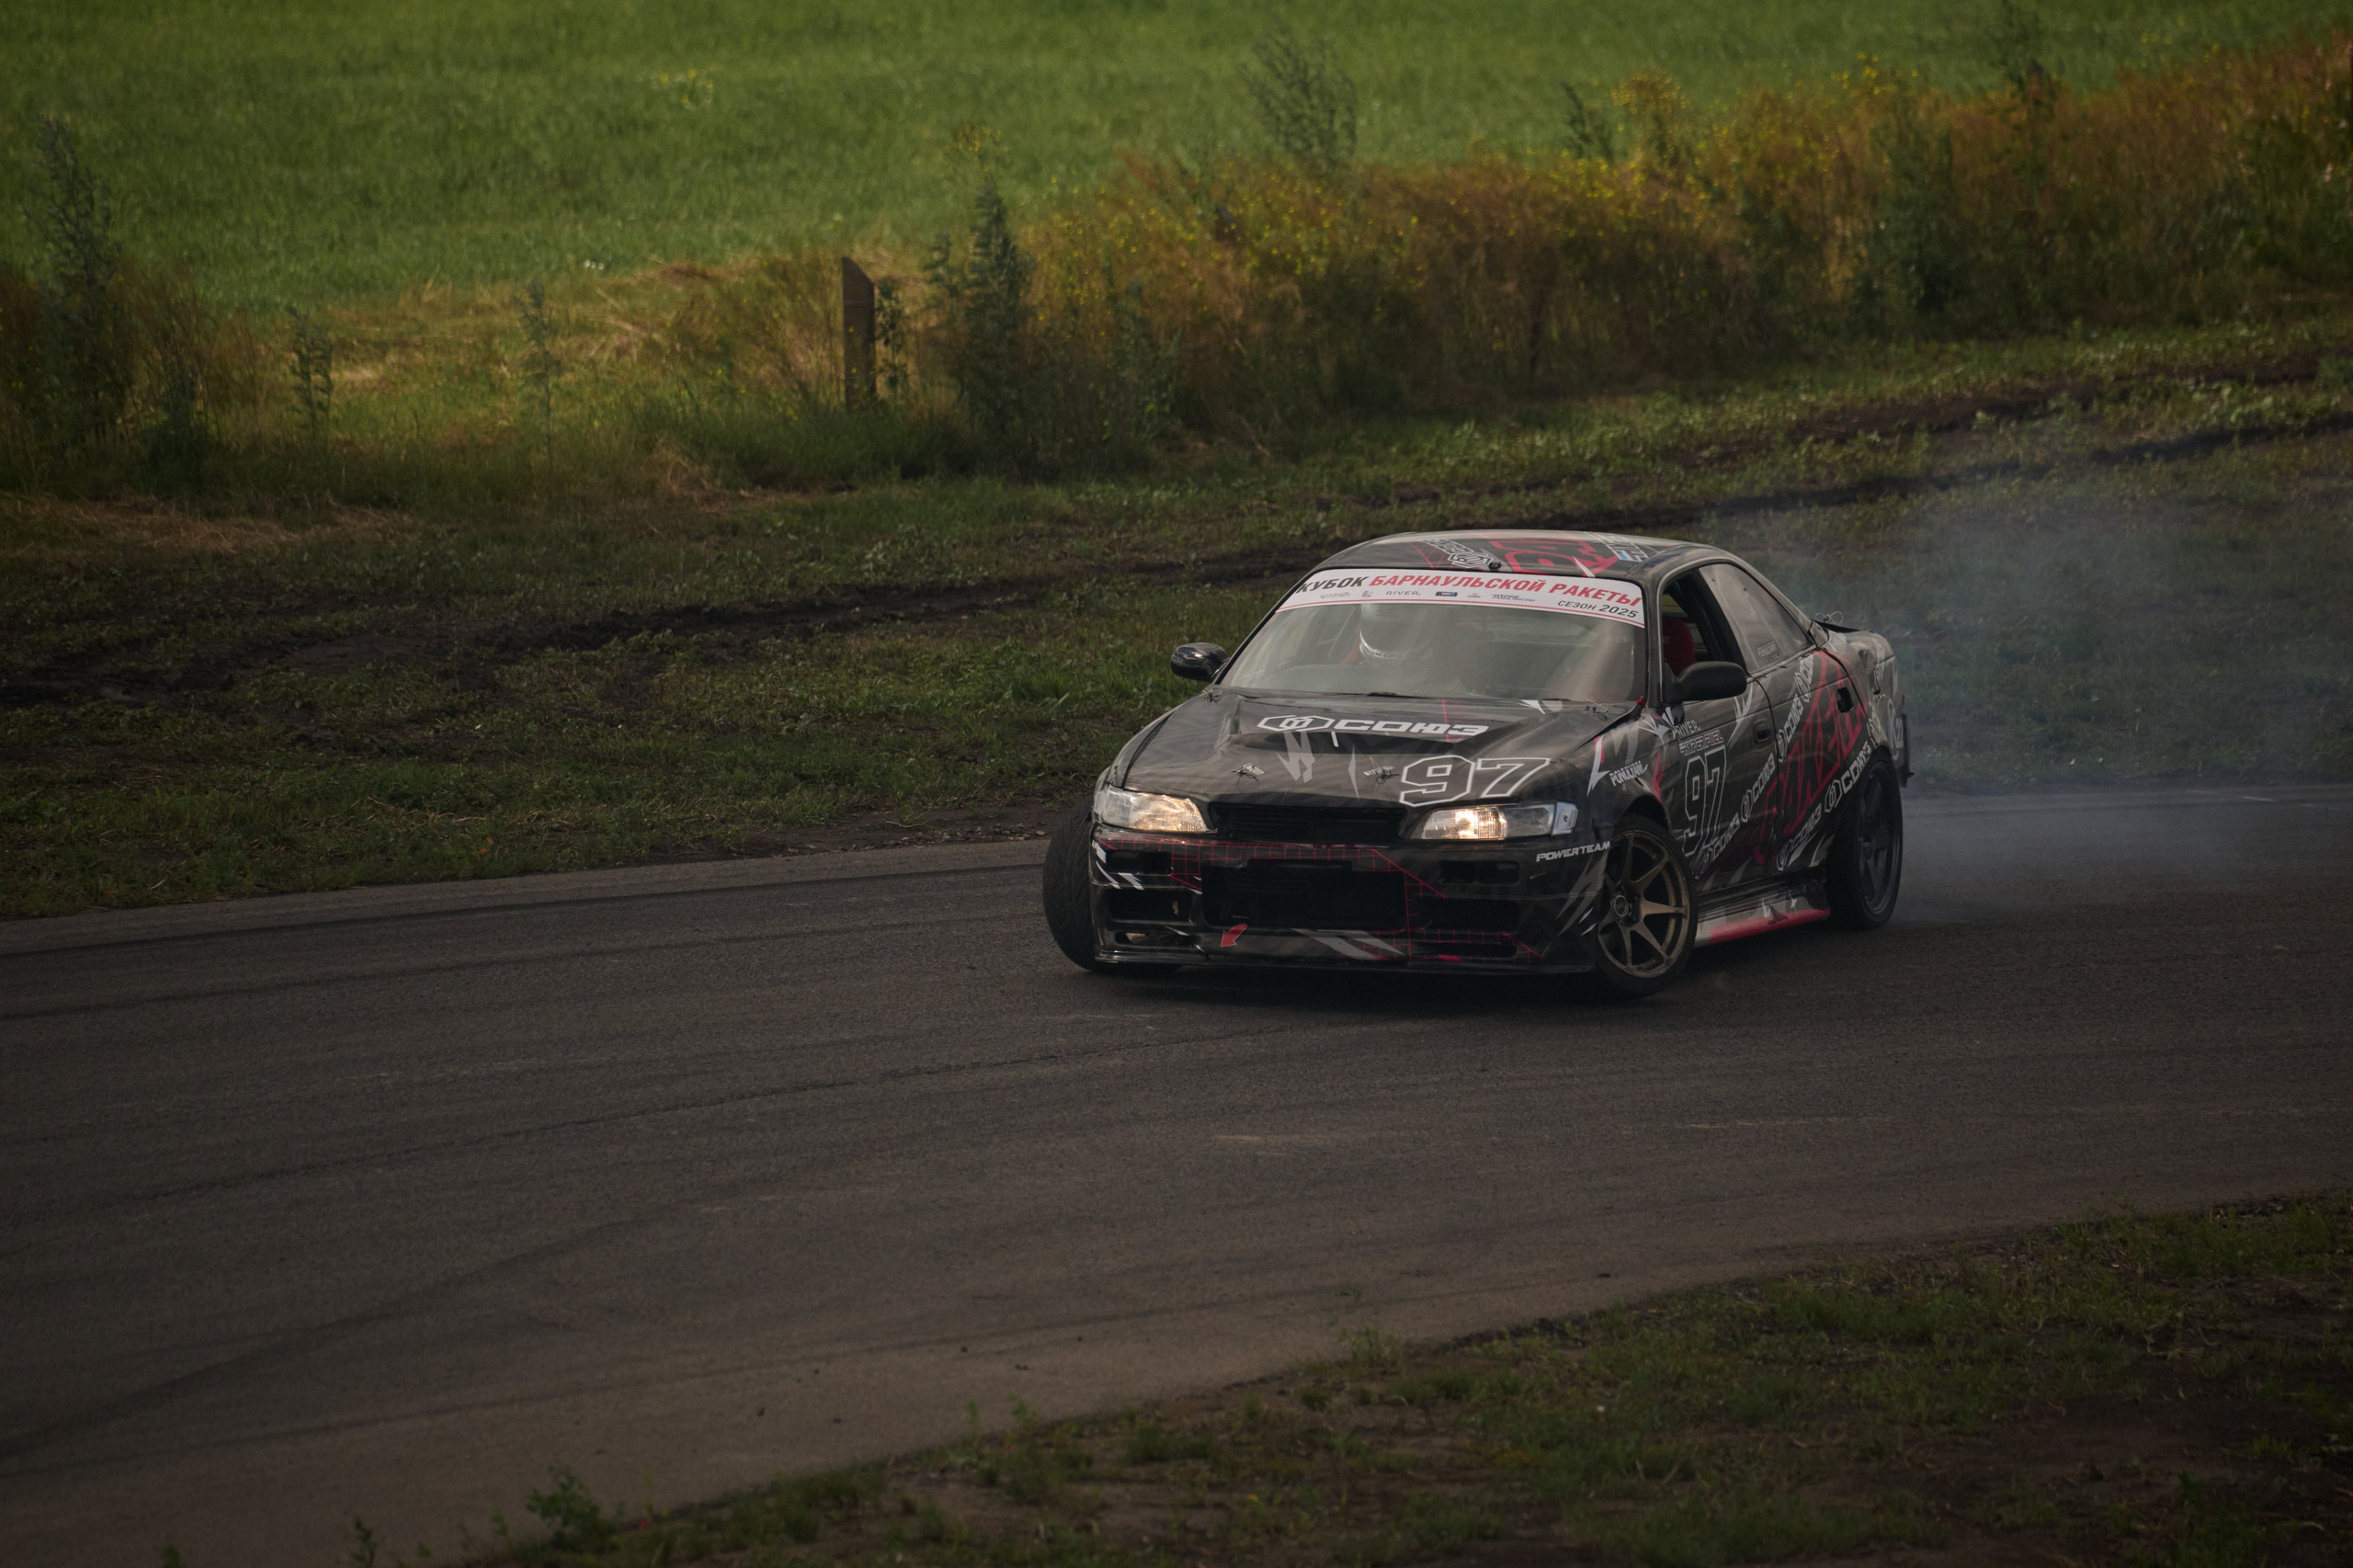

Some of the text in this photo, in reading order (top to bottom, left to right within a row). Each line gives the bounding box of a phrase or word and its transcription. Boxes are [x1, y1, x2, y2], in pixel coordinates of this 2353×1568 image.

[1295, 576, 1370, 594] КУБОК
[1369, 574, 1547, 592] БАРНАУЛЬСКОЙ
[1549, 583, 1643, 607] РАКЕТЫ
[1558, 600, 1639, 618] СЕЗОН 2025
[1334, 719, 1490, 737] СОЮЗ
[1676, 721, 1701, 738] RIVER
[1784, 697, 1804, 744] СОЮЗ
[1399, 755, 1551, 807] 97
[1683, 746, 1726, 856] 97
[1752, 753, 1776, 804] СОЮЗ
[1790, 802, 1823, 852] СОЮЗ
